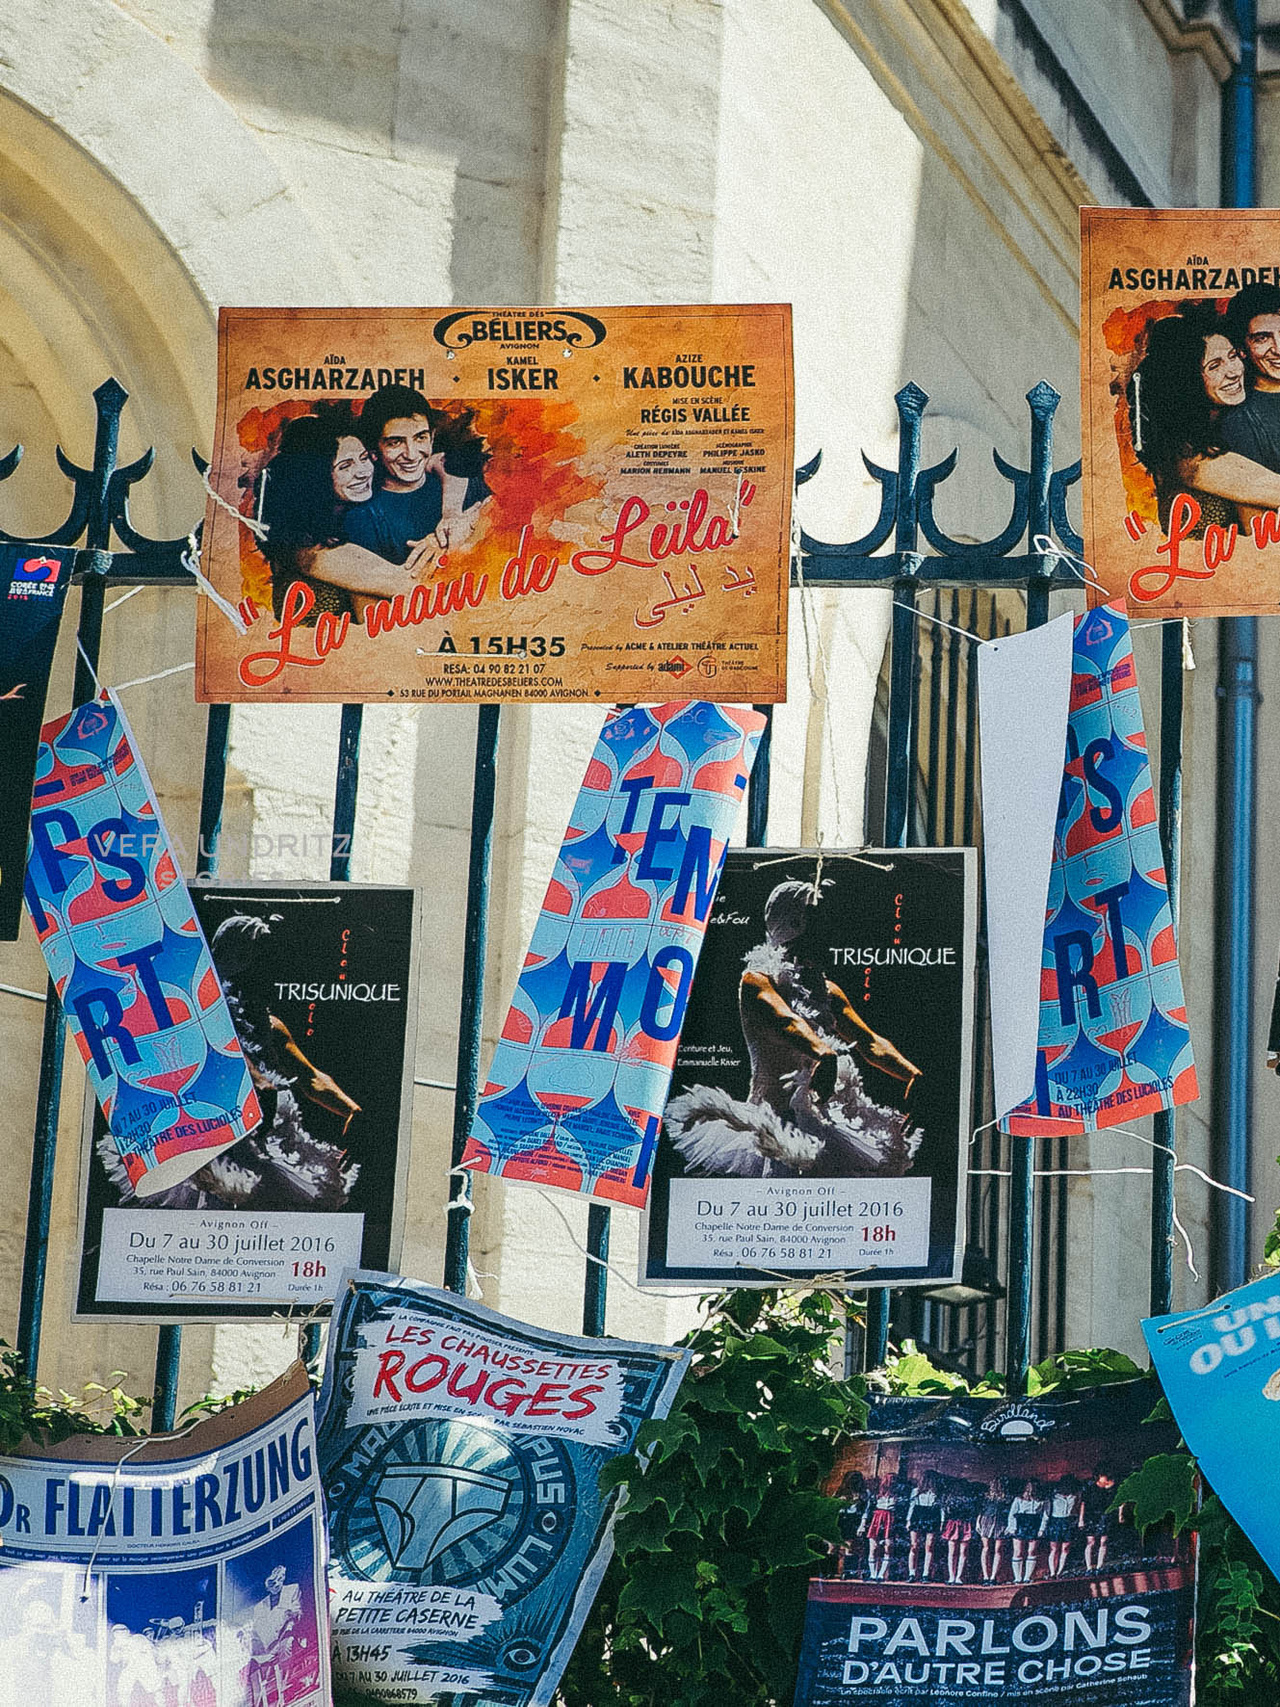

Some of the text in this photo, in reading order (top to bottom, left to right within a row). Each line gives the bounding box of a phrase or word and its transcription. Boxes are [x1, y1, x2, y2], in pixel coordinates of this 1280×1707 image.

[473, 318, 567, 342] BÉLIERS
[324, 354, 346, 365] AÏDA
[507, 356, 539, 365] KAMEL
[675, 354, 703, 363] AZIZE
[245, 368, 424, 390] ASGHARZADEH
[488, 368, 559, 390] ISKER
[623, 365, 755, 389] KABOUCHE
[701, 395, 723, 404] SCÈNE
[641, 404, 750, 423] RÉGIS VALLÉE
[366, 557, 489, 639] main
[501, 524, 560, 600] de
[438, 630, 565, 657] À 15H35
[625, 643, 647, 651] ACME
[648, 643, 655, 651] &
[657, 643, 688, 651] ATELIER
[729, 643, 759, 651] ACTUEL
[444, 663, 546, 674] RESA: 04 90 82 21 07
[426, 677, 563, 687] WWW.THEATREDESBELIERS.COM
[400, 689, 588, 698] 53 RUE DU PORTAIL MAGNANEN 84000 AVIGNON
[829, 947, 957, 966] TRISUNIQUE
[274, 982, 400, 1001] TRISUNIQUE
[1116, 1075, 1174, 1104] DES LUCIOLES
[767, 1186, 836, 1197] Avignon Off
[697, 1200, 904, 1221] Du 7 au 30 juillet 2016
[695, 1222, 854, 1233] Chapelle Notre Dame de Conversion
[861, 1225, 896, 1242] 18h
[291, 1260, 326, 1278] 18h
[385, 1324, 613, 1380] LES CHAUSSETTES
[1189, 1327, 1256, 1375] OU
[373, 1349, 605, 1420] ROUGES
[45, 1416, 311, 1537] FLATTERZUNG
[342, 1590, 364, 1601] AU
[430, 1591, 450, 1603] DE
[454, 1594, 475, 1611] LA
[335, 1607, 480, 1630] PETITE CASERNE
[848, 1605, 1151, 1657] PARLONS
[346, 1645, 392, 1663] 13H45
[842, 1648, 1151, 1686] D'AUTRE CHOSE
[391, 1670, 470, 1684] JUILLET 2016
